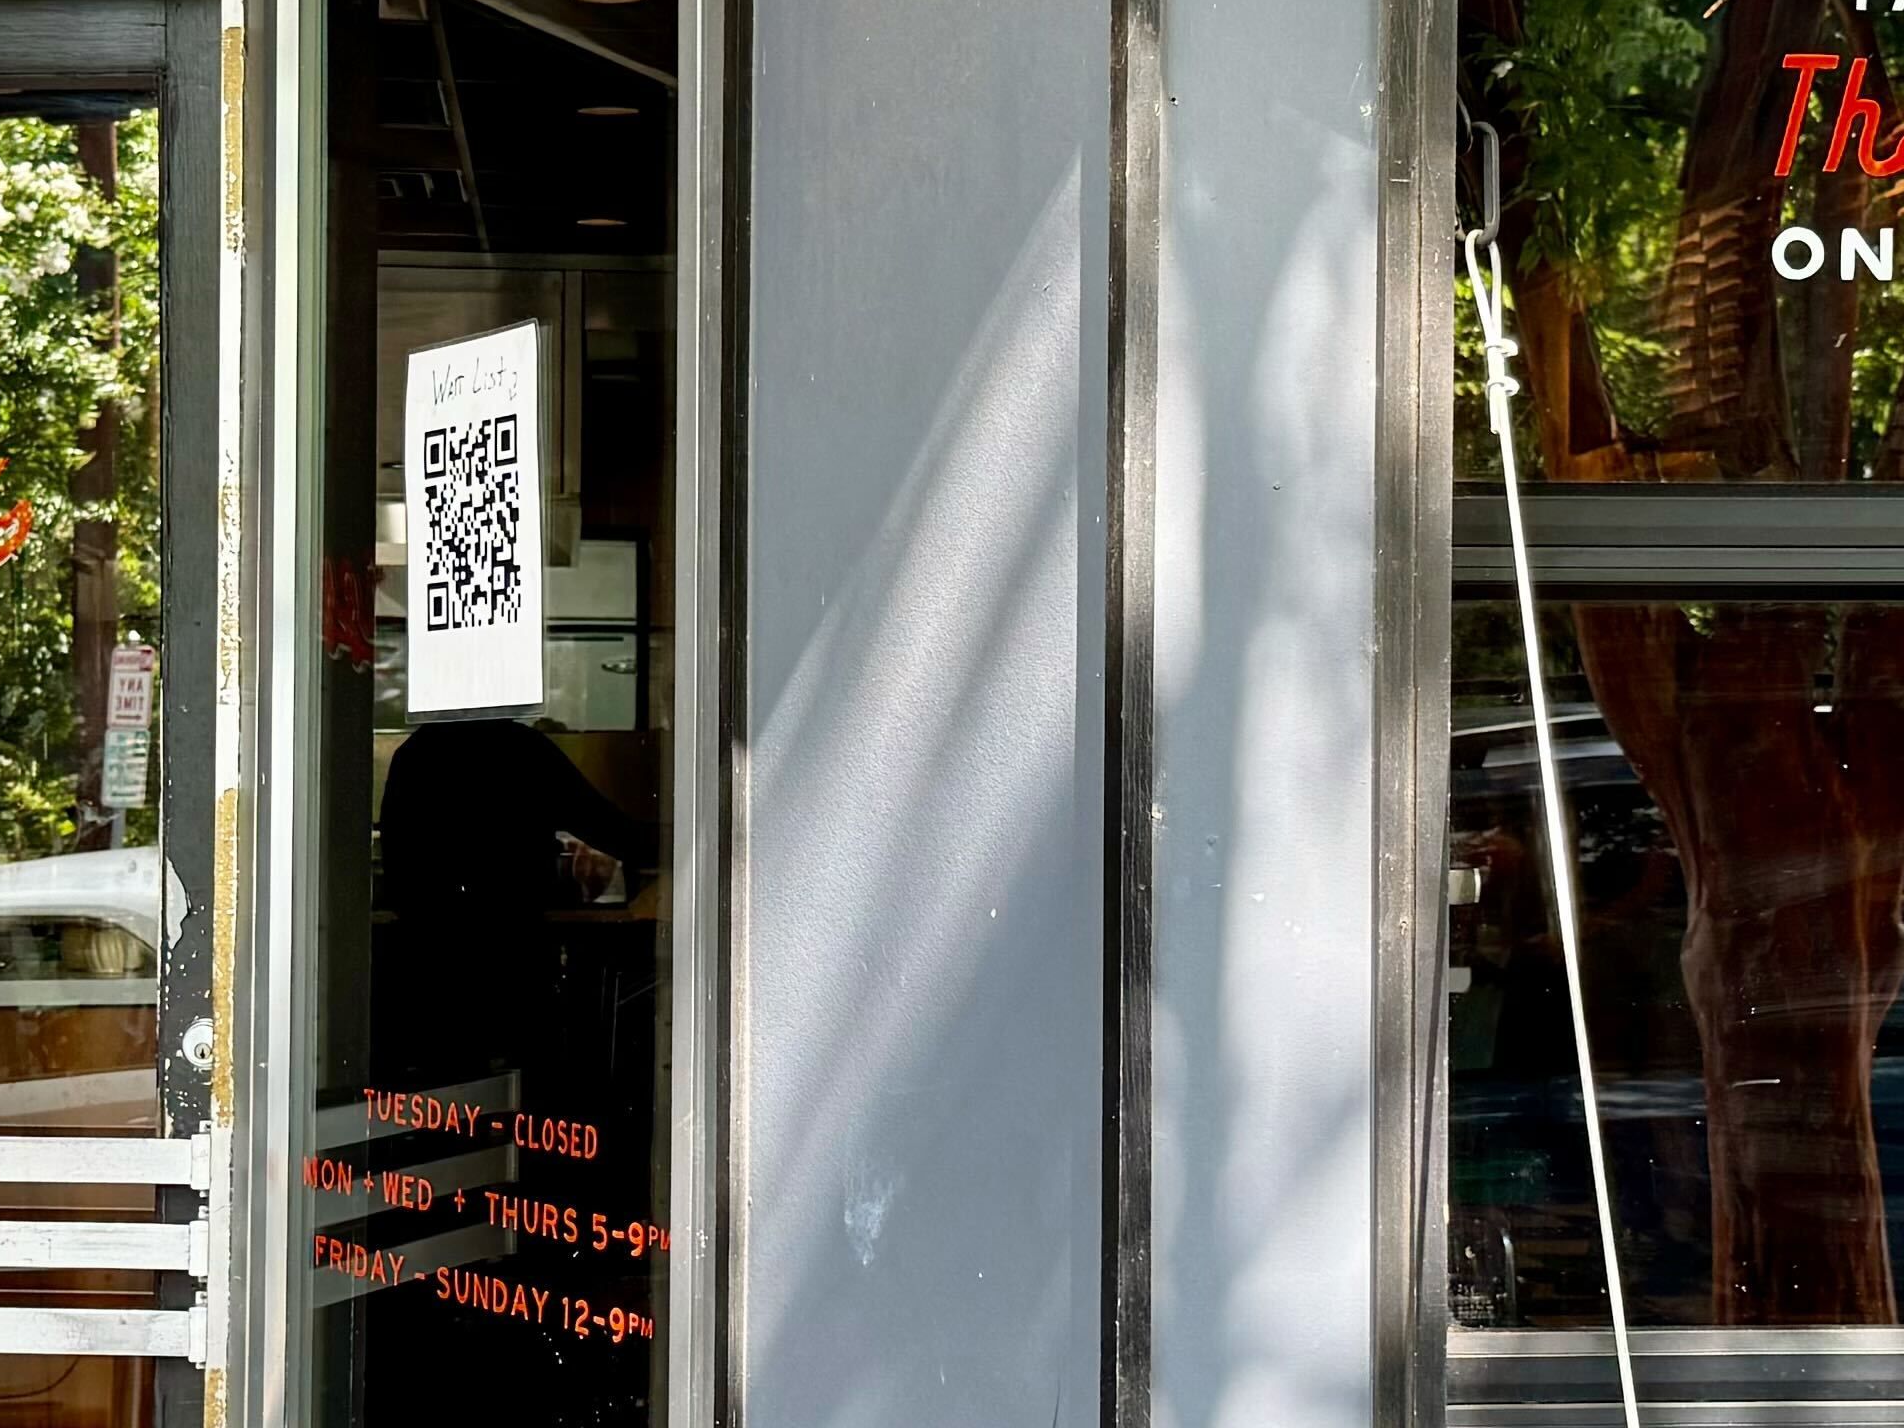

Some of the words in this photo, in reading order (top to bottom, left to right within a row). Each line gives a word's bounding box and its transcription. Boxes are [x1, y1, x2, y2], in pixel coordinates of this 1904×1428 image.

[1770, 225, 1895, 282] ON
[363, 1088, 481, 1138] TUESDAY
[513, 1112, 598, 1161] CLOSED
[302, 1155, 353, 1197] MON
[382, 1169, 433, 1212] WED
[484, 1190, 578, 1243] THURS
[313, 1233, 405, 1287] FRIDAY
[435, 1265, 550, 1324] SUNDAY
